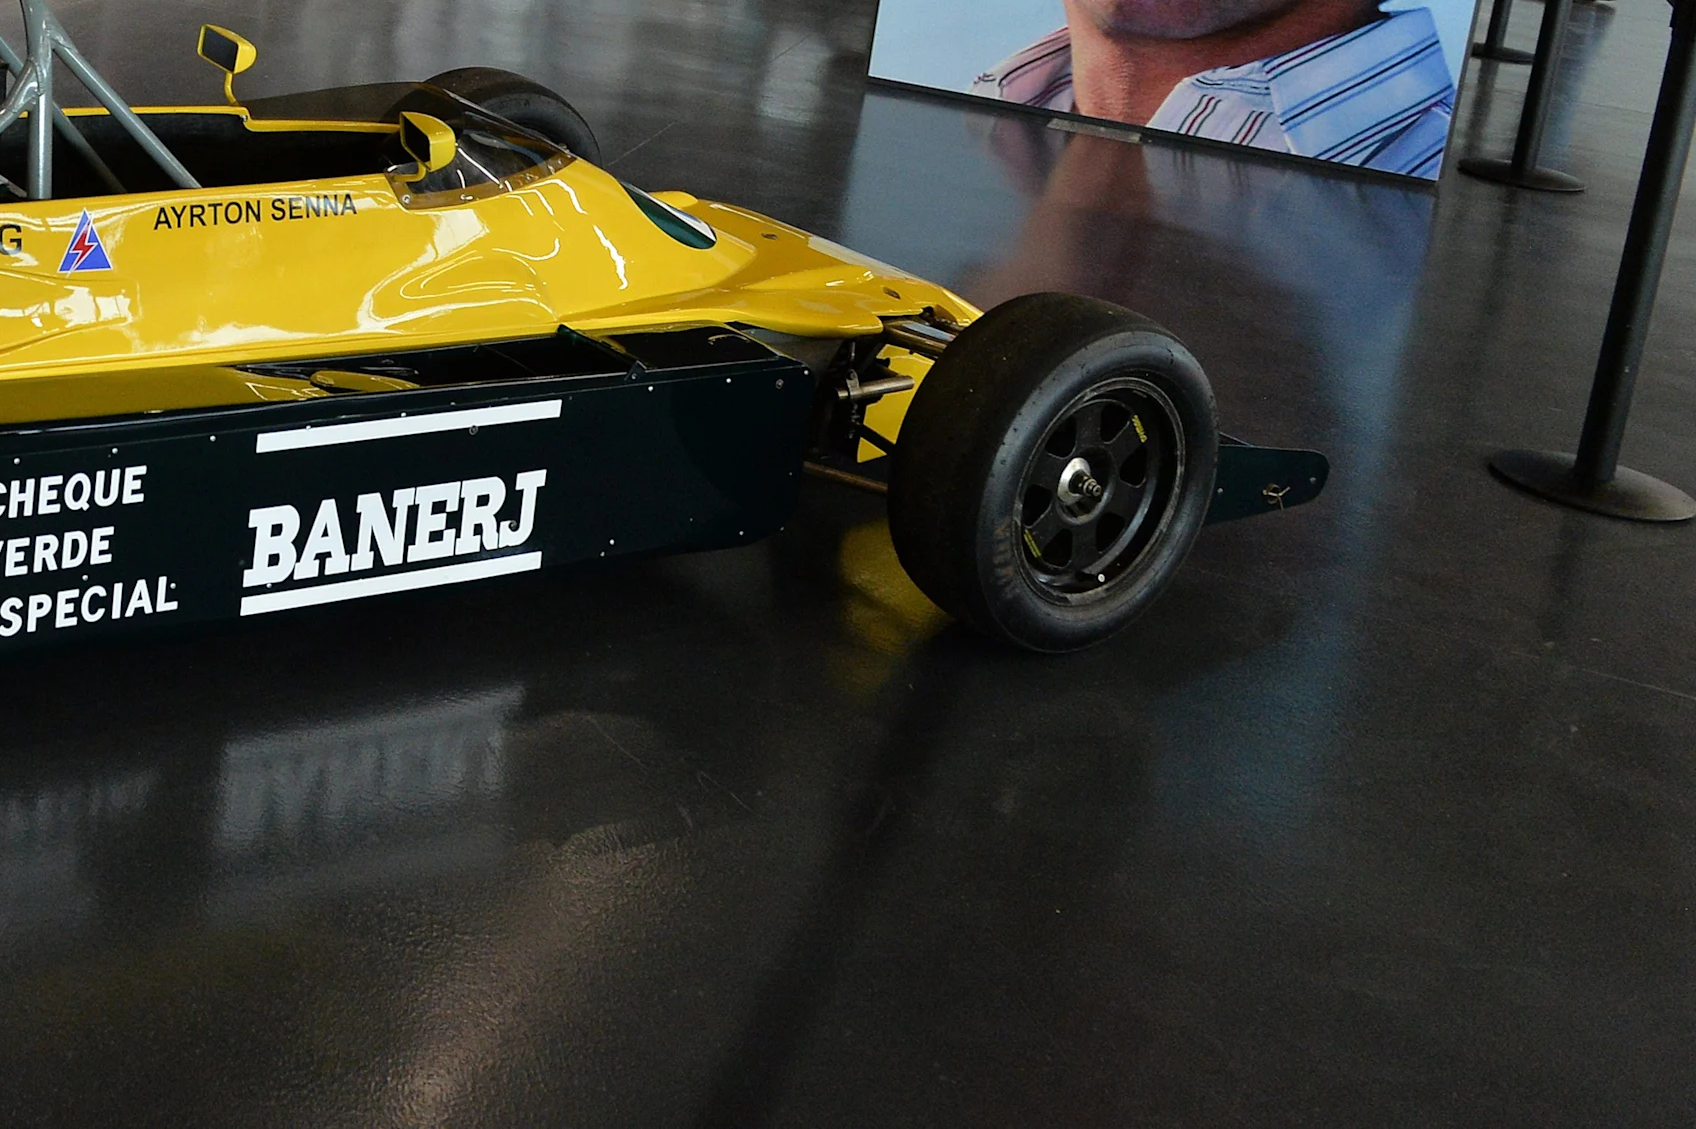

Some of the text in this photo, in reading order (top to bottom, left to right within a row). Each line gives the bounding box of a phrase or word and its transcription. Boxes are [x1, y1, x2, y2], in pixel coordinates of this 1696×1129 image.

[153, 199, 263, 232] AYRTON
[270, 193, 358, 224] SENNA
[242, 469, 547, 589] BANERJ
